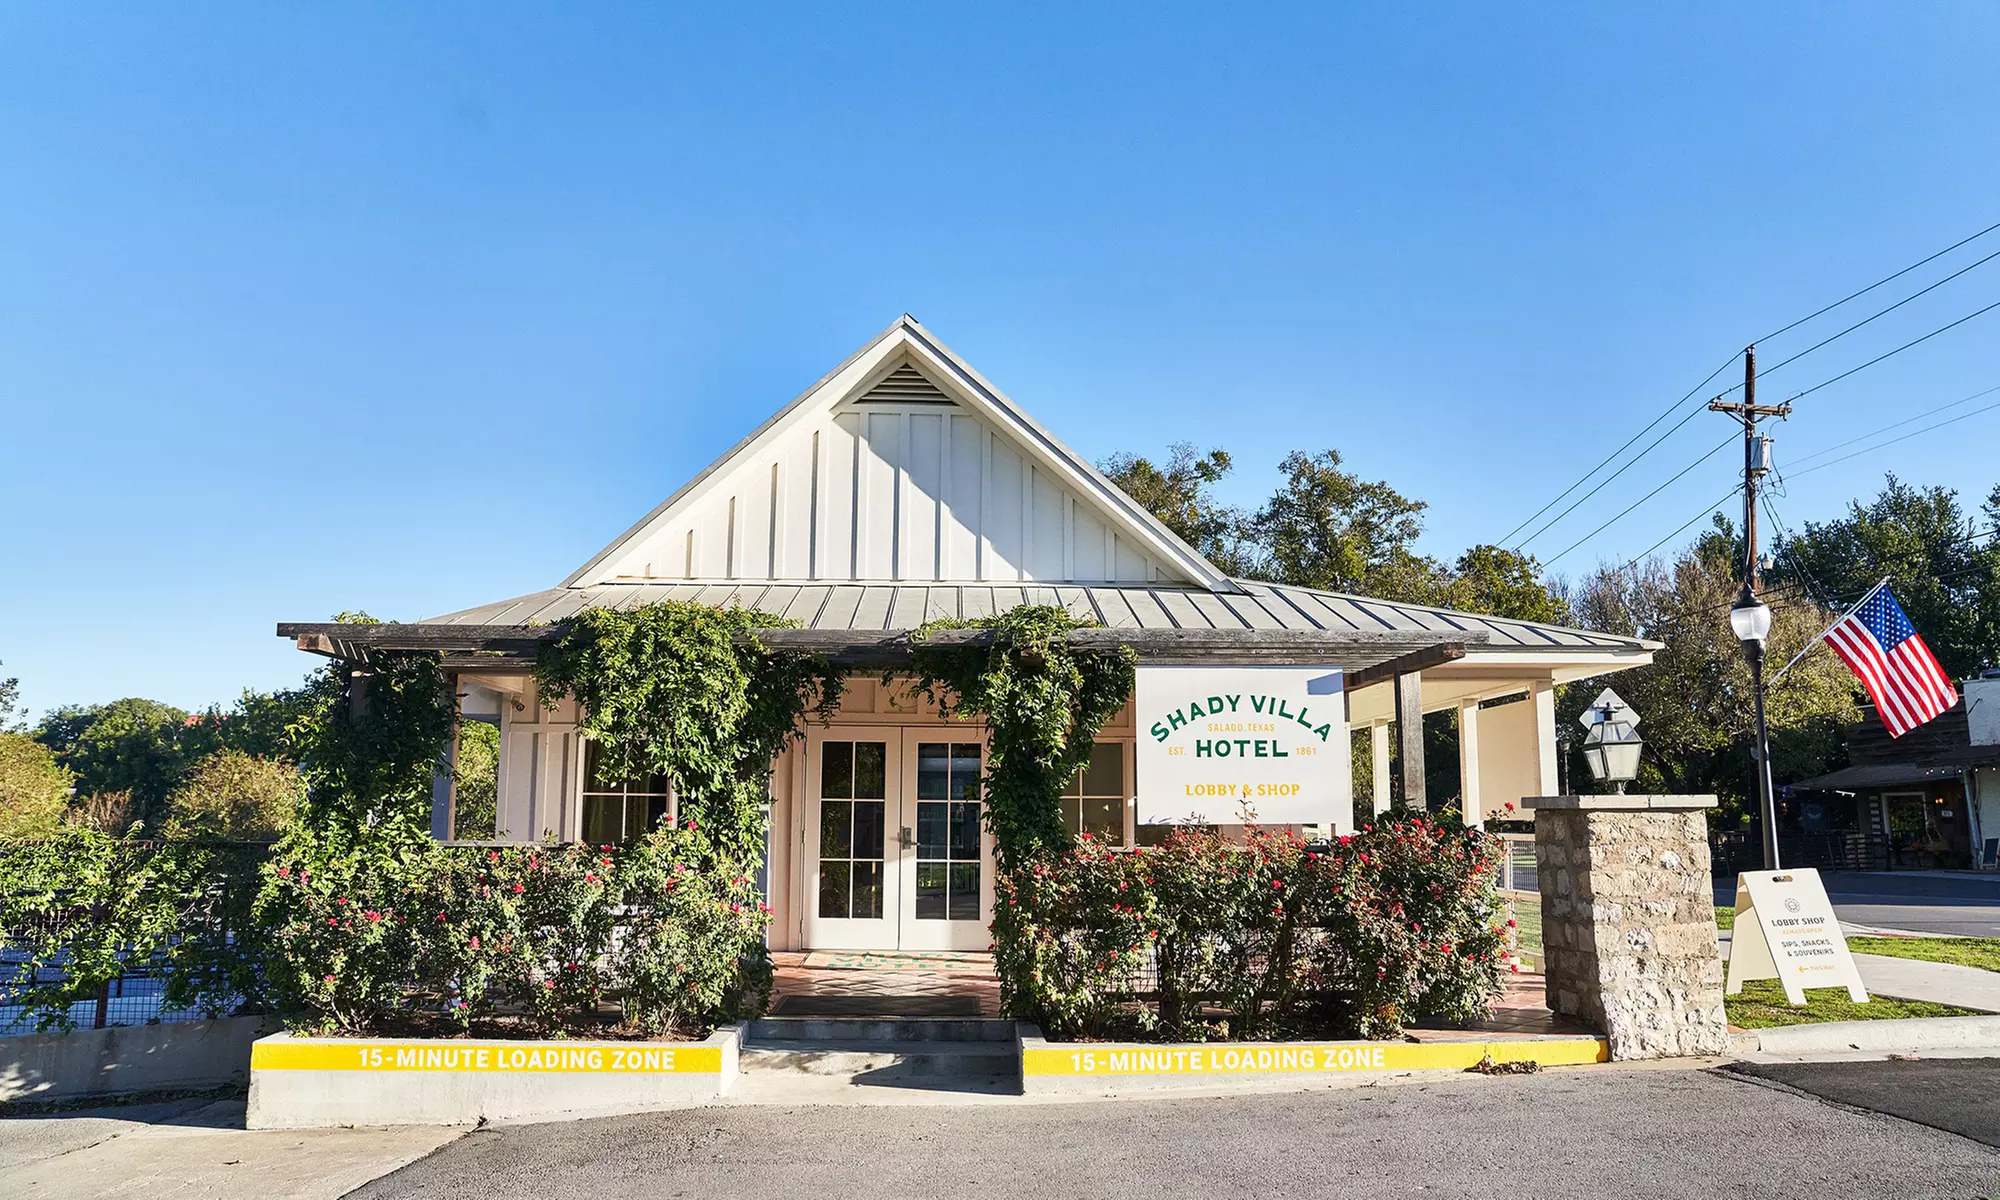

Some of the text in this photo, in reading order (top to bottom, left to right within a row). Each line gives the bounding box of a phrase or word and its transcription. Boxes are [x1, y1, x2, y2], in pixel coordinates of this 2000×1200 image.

[1150, 694, 1332, 743] SHADY VILLA
[1248, 723, 1275, 732] TEXAS
[1168, 747, 1186, 756] EST.
[1196, 740, 1288, 758] HOTEL
[1296, 747, 1317, 756] 1861
[1185, 784, 1300, 796] LOBBY & SHOP
[1771, 917, 1825, 927] LOBBY SHOP
[1793, 948, 1834, 957] SOUVENIRS
[359, 1048, 676, 1070] 15-MINUTE LOADING ZONE
[1071, 1048, 1386, 1072] 15-MINUTE LOADING ZONE
